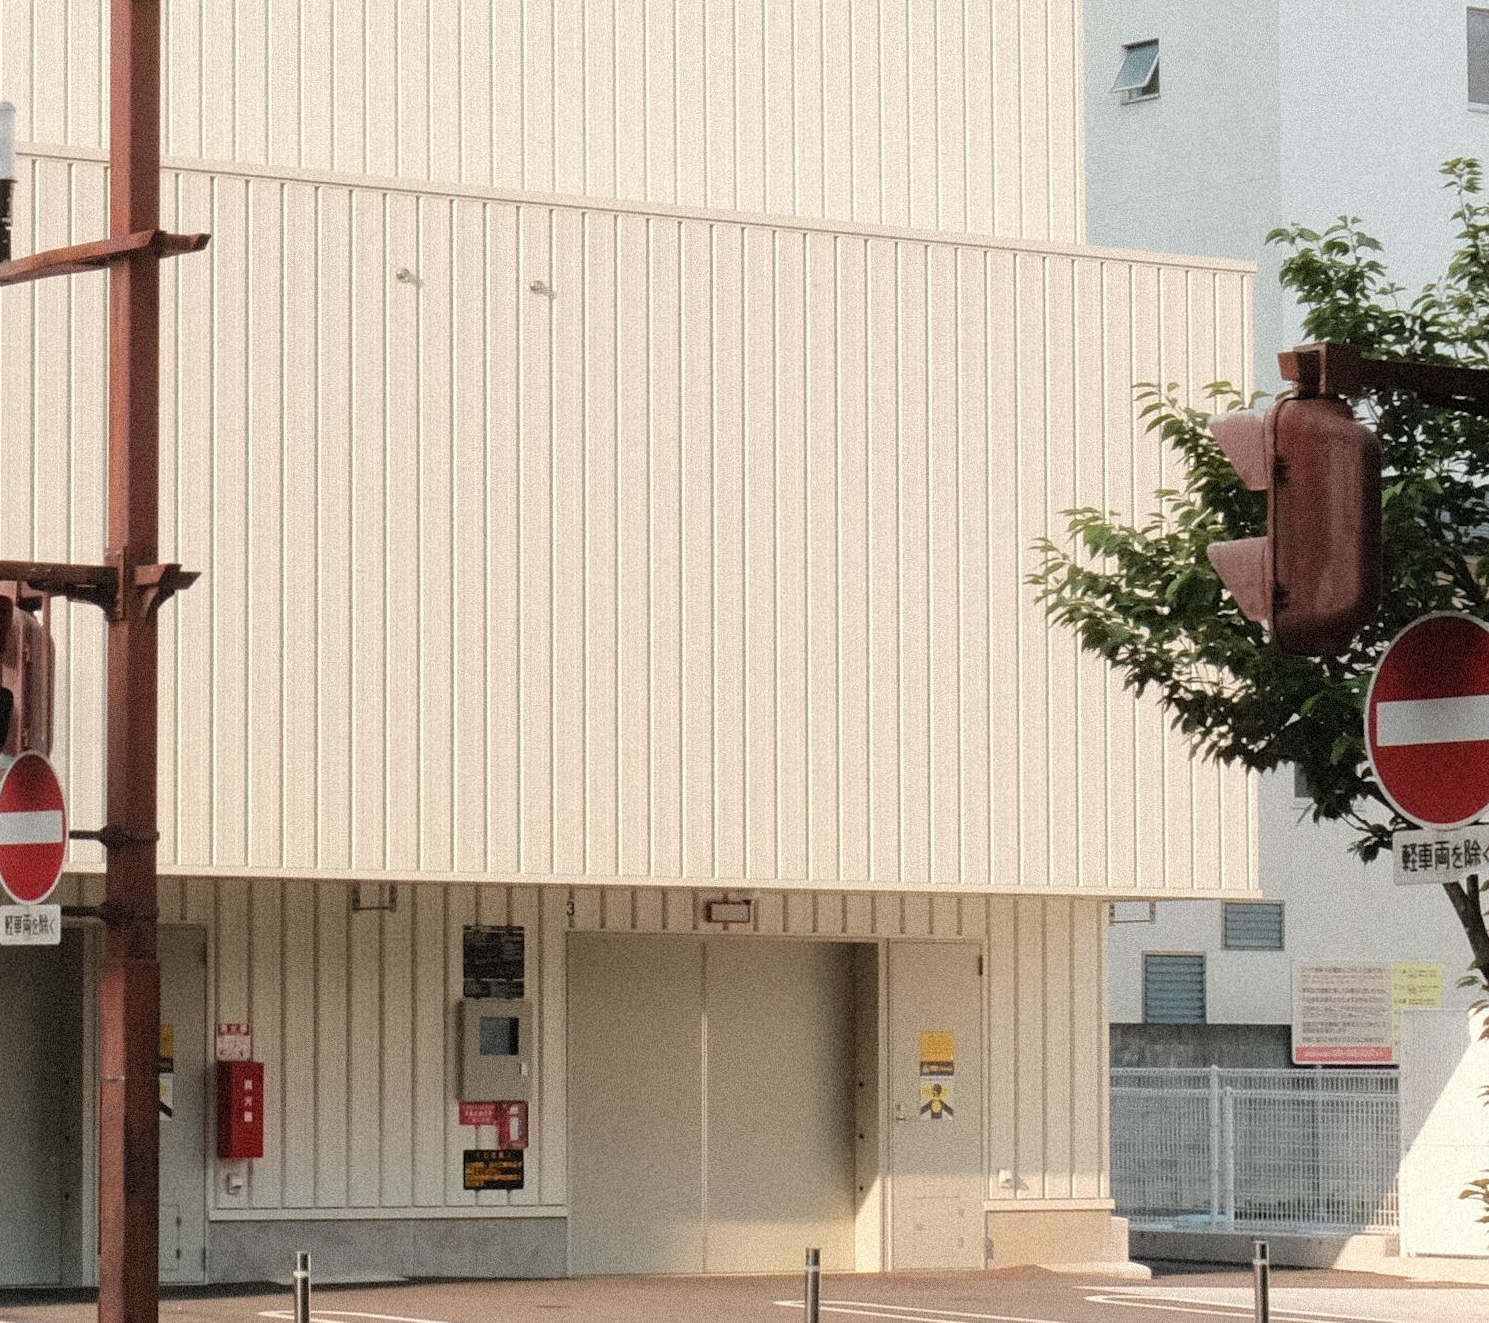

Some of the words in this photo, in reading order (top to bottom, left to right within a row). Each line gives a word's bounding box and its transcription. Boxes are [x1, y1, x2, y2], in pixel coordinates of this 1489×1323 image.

[1402, 838, 1489, 871] 軽車両を除く
[566, 900, 575, 917] 3
